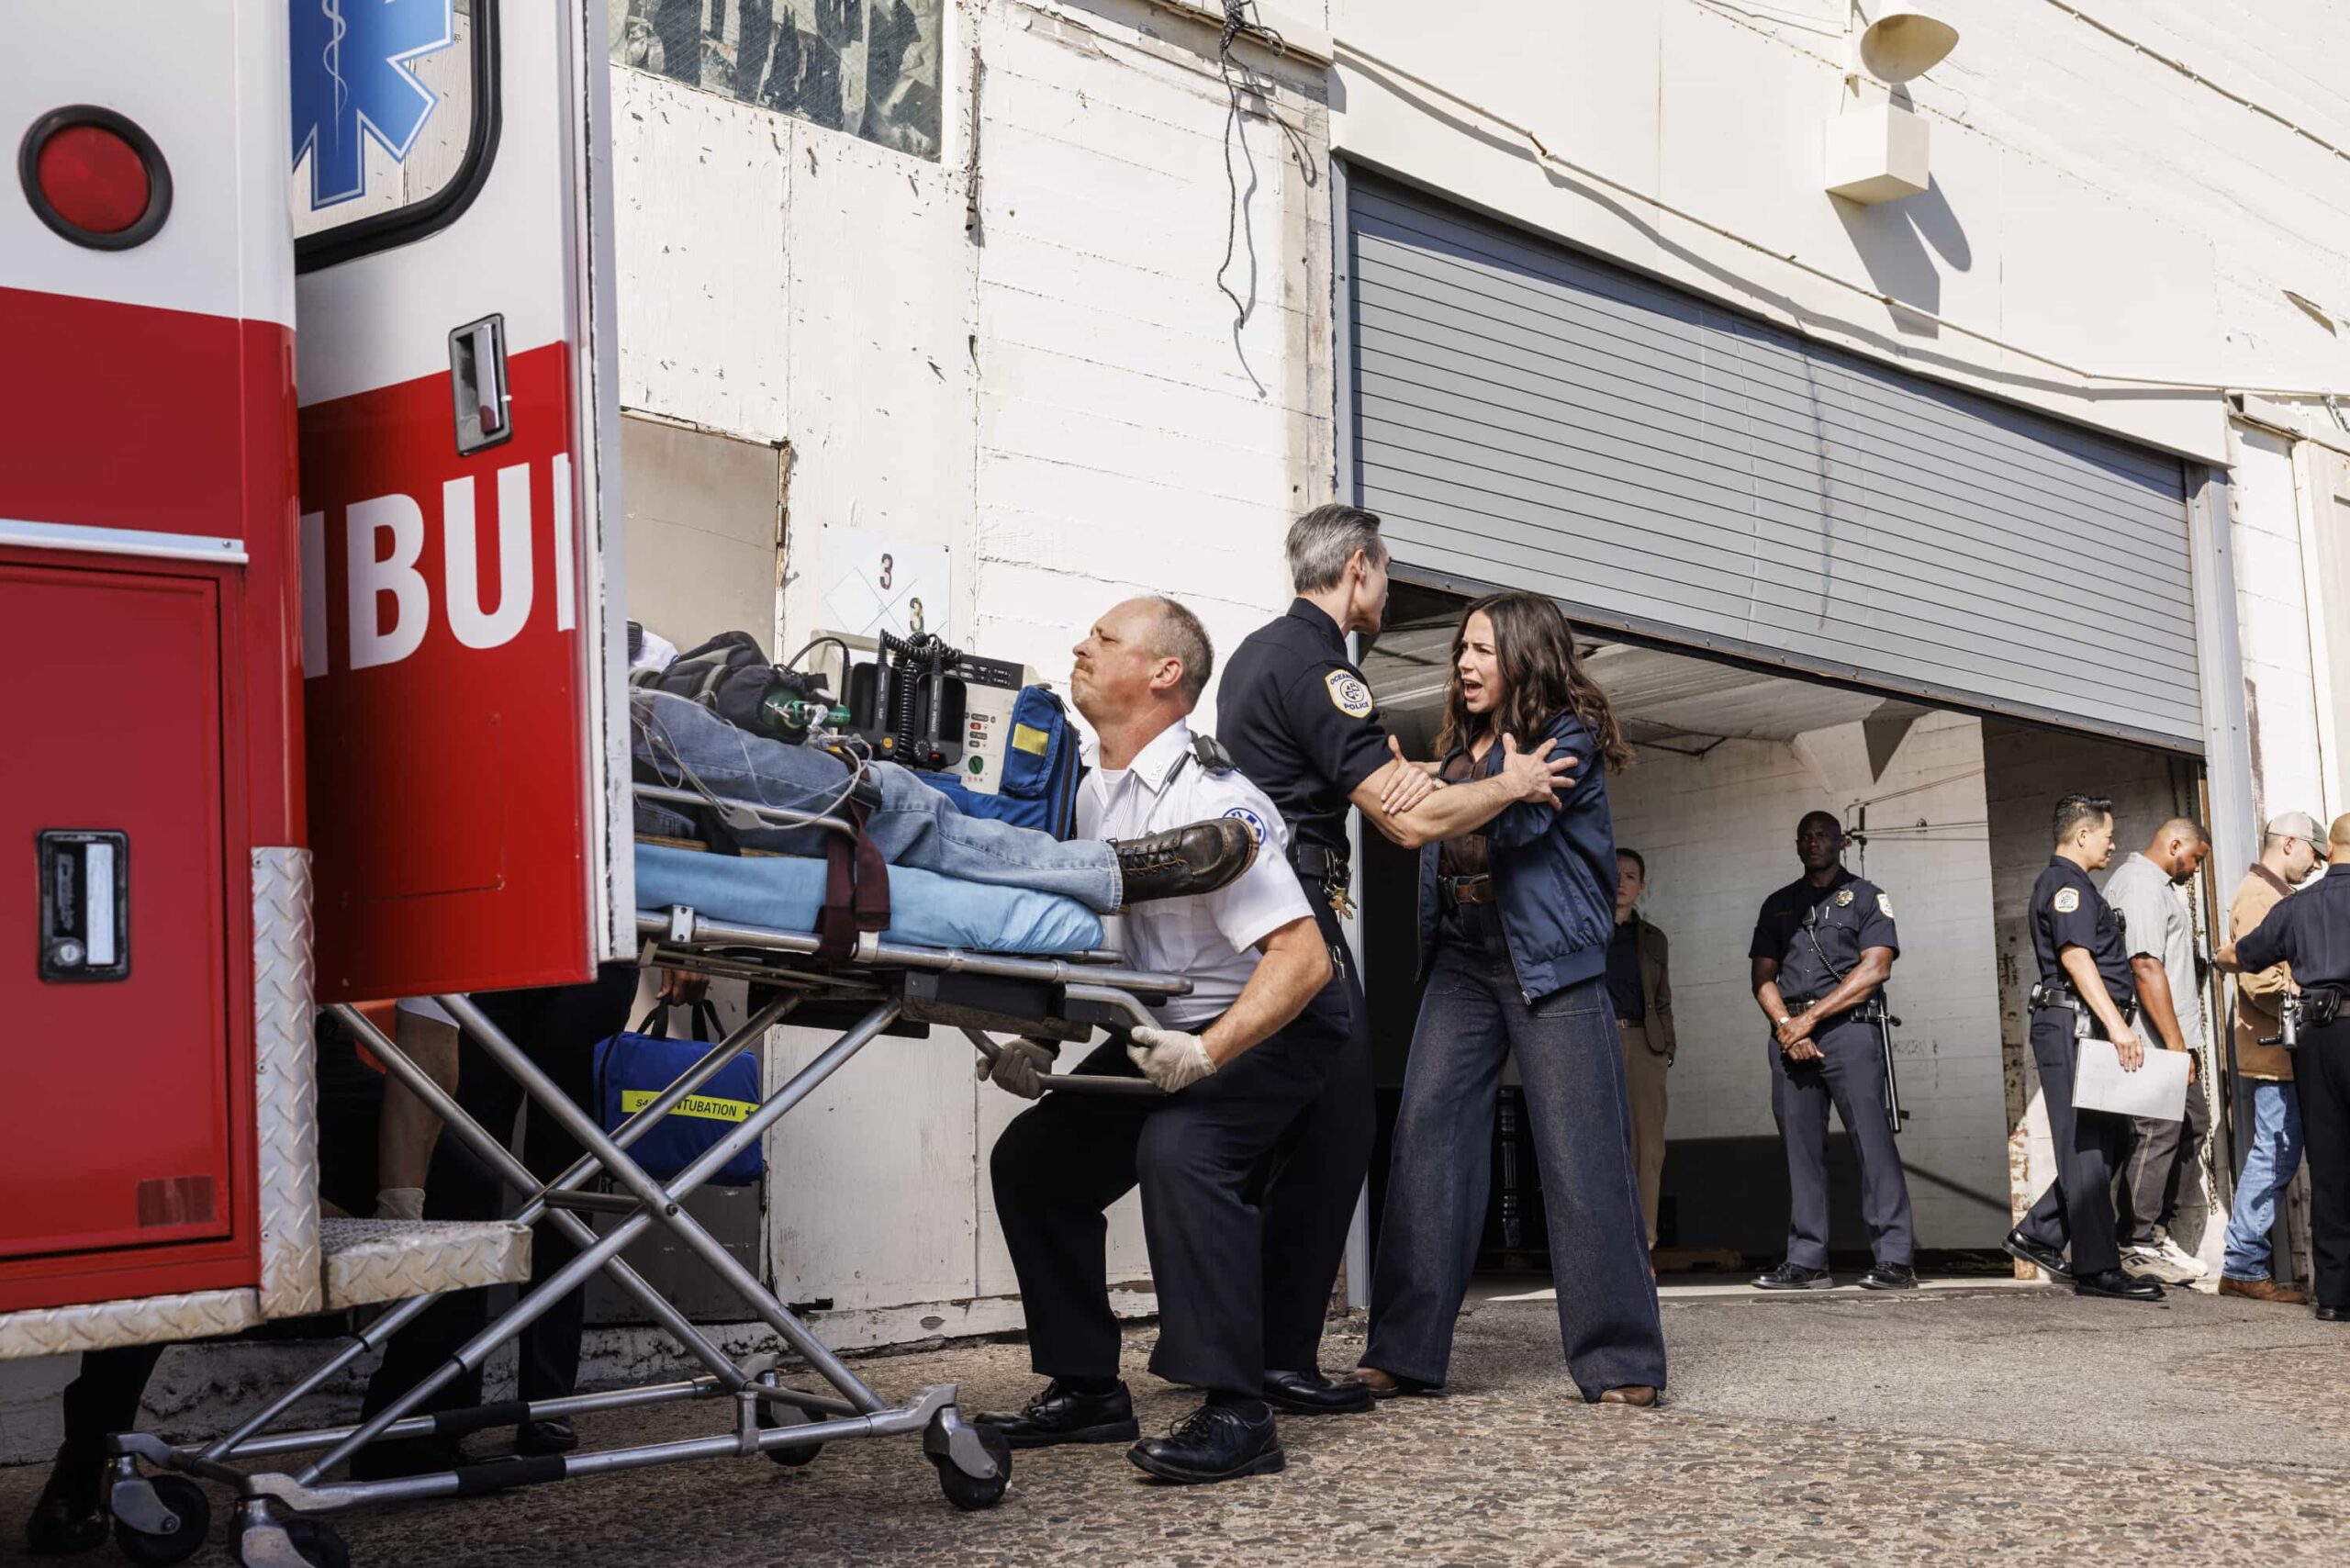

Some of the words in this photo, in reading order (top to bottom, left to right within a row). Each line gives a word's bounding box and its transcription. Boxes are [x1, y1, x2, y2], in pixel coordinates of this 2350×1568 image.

[879, 553, 893, 590] 3
[910, 597, 924, 633] 3
[1343, 701, 1369, 711] POLICE
[676, 1099, 737, 1116] NTUBATION
